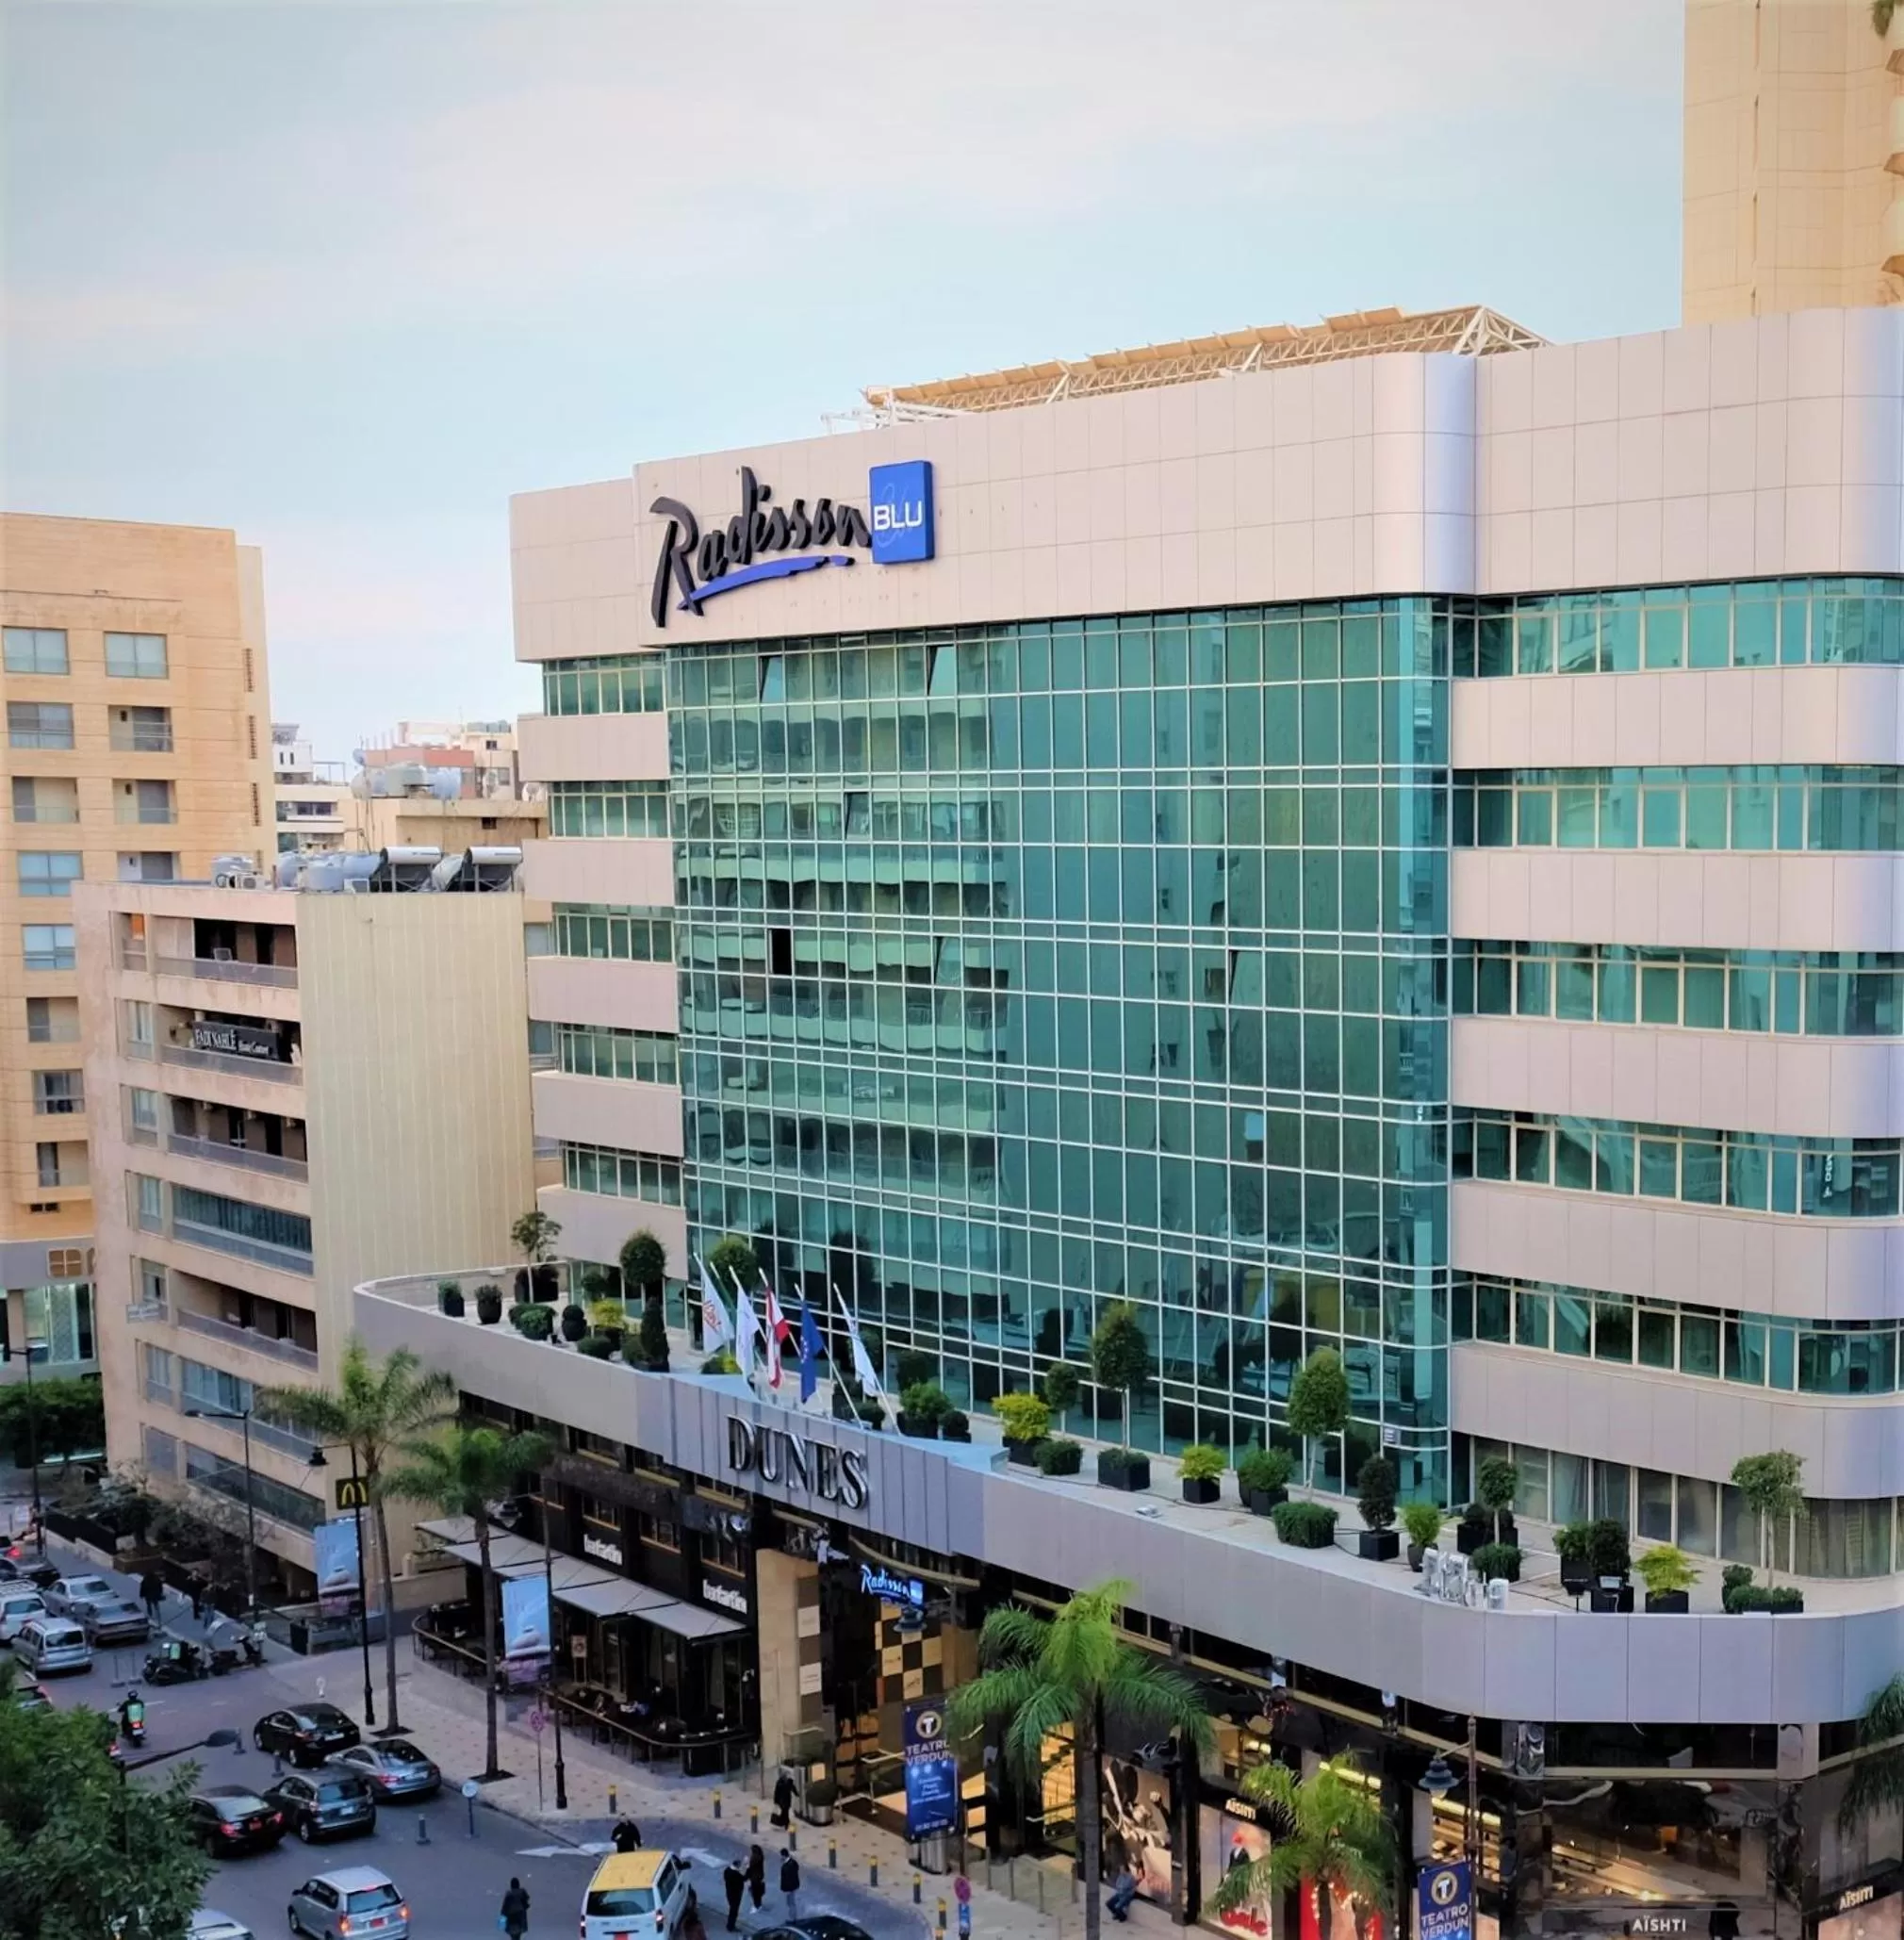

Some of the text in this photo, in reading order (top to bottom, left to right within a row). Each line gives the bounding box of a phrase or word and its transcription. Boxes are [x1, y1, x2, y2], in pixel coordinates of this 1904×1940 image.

[650, 466, 924, 628] Radisson BLU
[726, 1414, 868, 1509] DUNES
[1420, 1902, 1469, 1927] TEATRO
[1632, 1915, 1687, 1932] AÏSHTI
[1420, 1915, 1469, 1940] VERDUN
